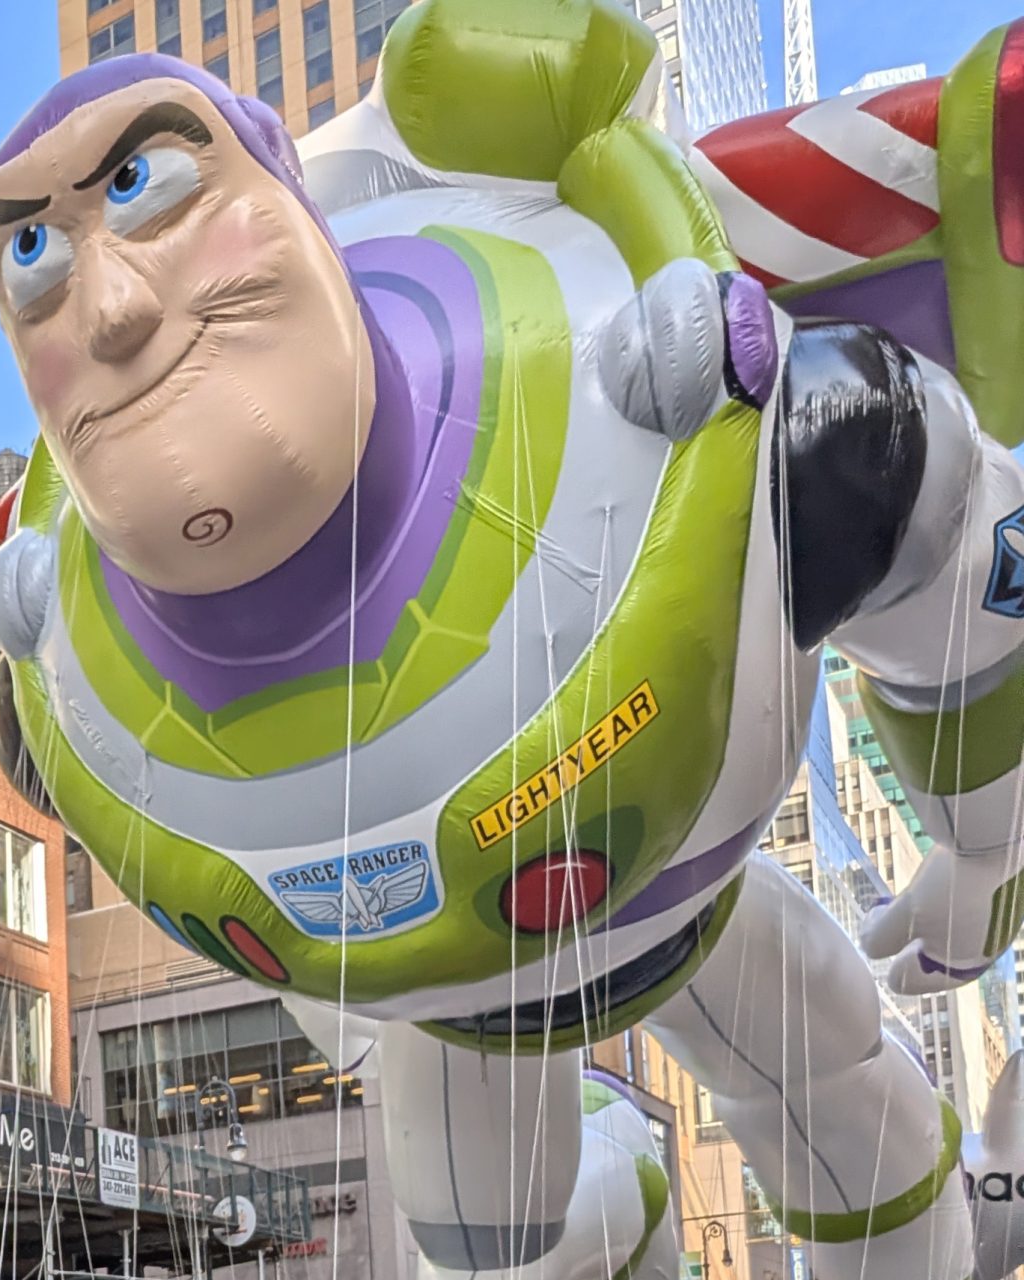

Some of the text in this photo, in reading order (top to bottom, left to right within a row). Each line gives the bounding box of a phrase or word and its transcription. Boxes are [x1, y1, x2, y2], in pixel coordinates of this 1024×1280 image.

[476, 691, 653, 843] LIGHTYEAR
[273, 844, 422, 889] SPACE RANGER
[0, 1113, 35, 1151] Me
[114, 1135, 136, 1163] ACE
